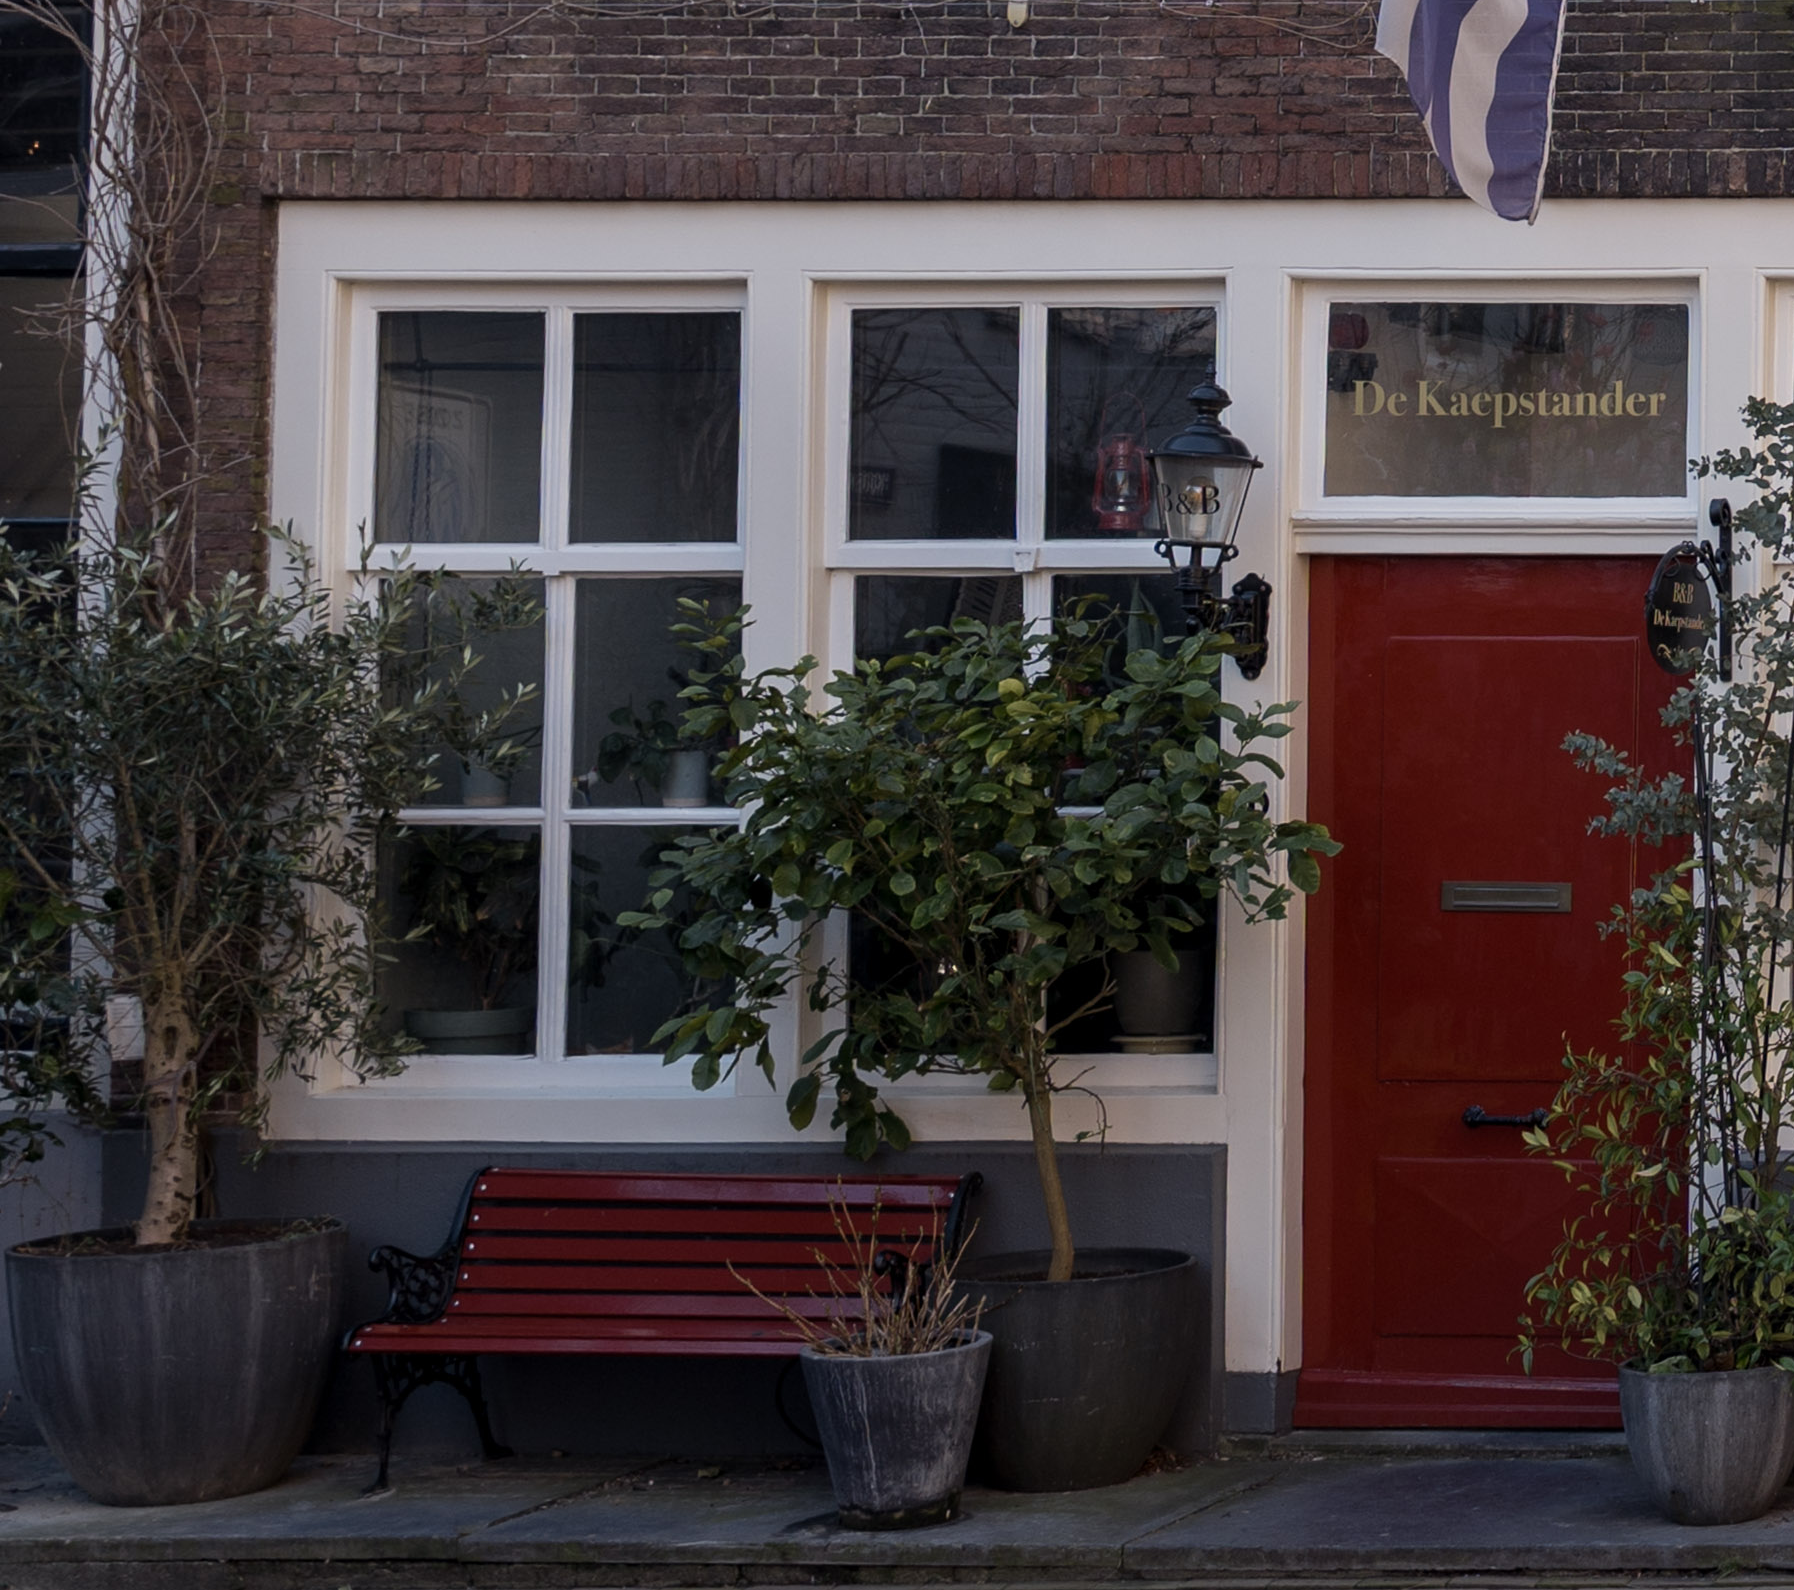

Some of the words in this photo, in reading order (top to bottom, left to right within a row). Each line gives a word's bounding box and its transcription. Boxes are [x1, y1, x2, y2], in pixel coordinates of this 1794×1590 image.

[1352, 379, 1408, 417] De
[1415, 379, 1667, 429] Kaepstander
[1673, 581, 1694, 604] B&B
